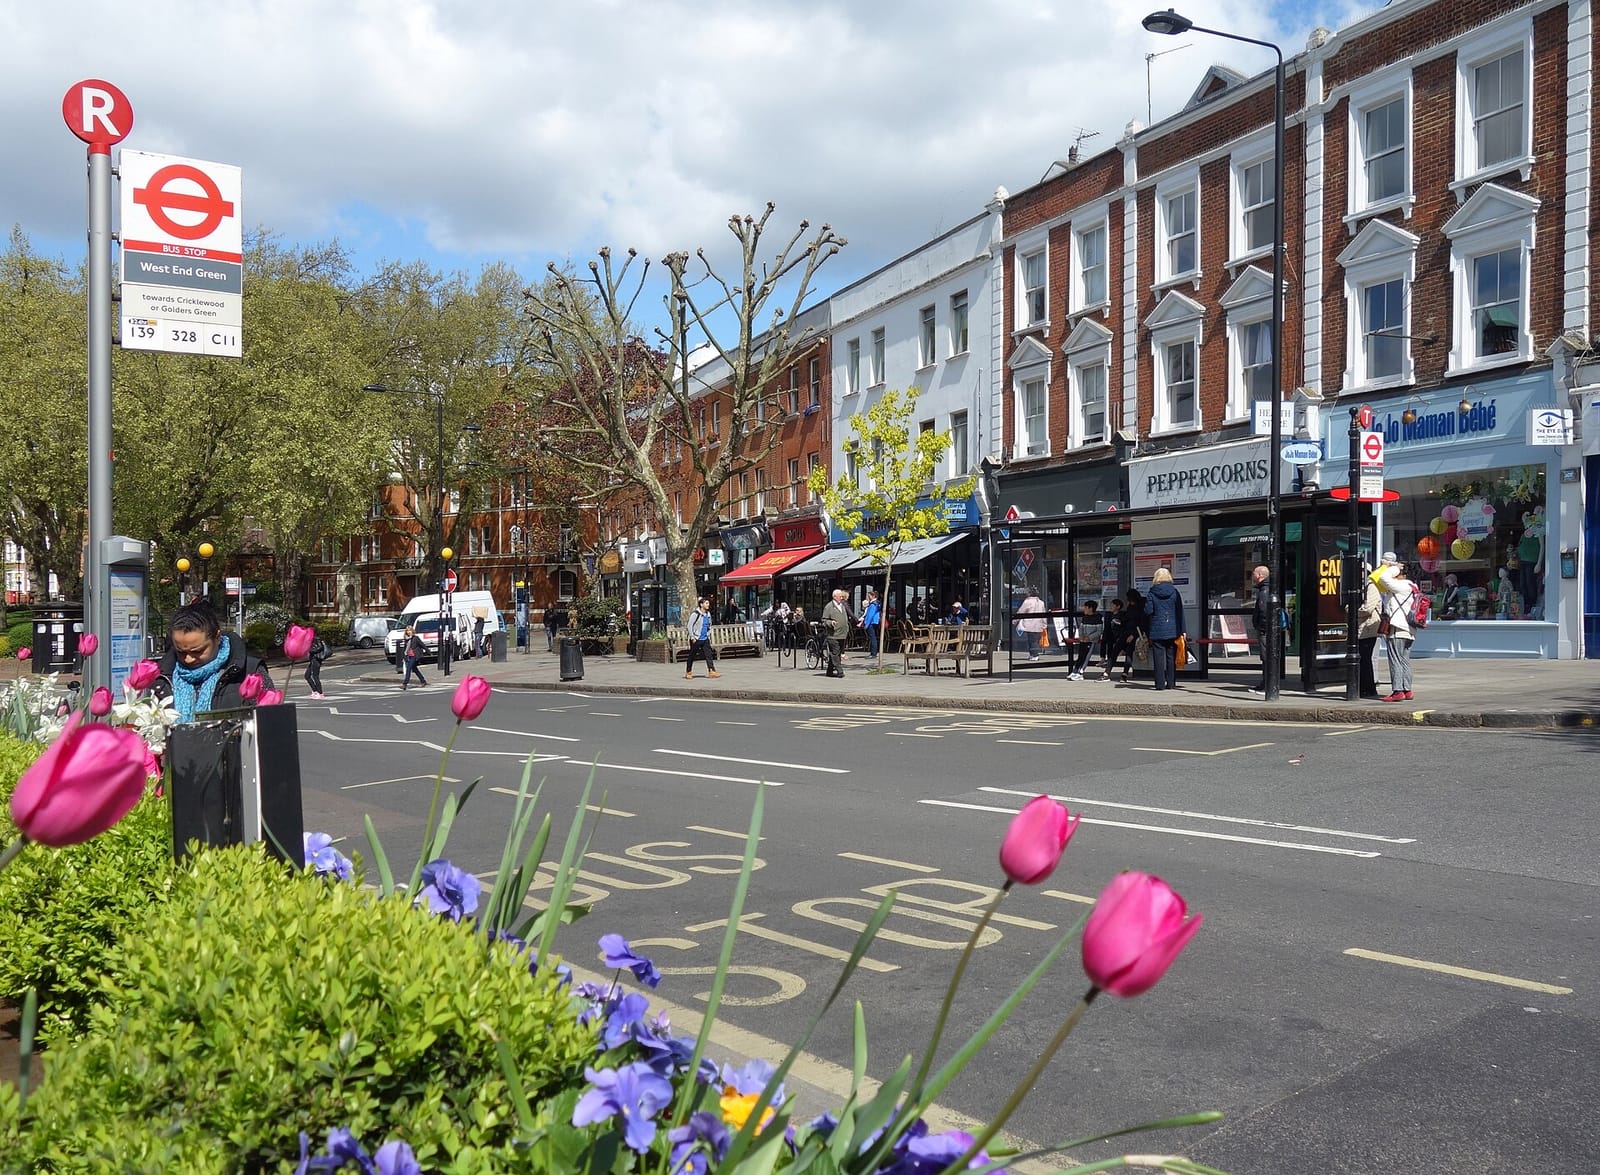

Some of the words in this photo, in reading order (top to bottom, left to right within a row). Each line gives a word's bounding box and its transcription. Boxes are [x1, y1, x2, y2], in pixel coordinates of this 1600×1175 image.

[82, 86, 121, 137] R
[162, 244, 180, 254] BUS
[184, 247, 207, 257] STOP
[140, 262, 170, 274] West
[172, 265, 193, 276] End
[195, 268, 227, 281] Green
[142, 294, 175, 303] towards
[176, 296, 225, 308] Cricklewood
[161, 305, 192, 314] Golders
[194, 308, 217, 317] Green
[131, 327, 155, 338] 139
[171, 330, 197, 342] 328
[211, 334, 235, 346] C11
[1259, 408, 1291, 418] HETH
[1363, 409, 1371, 425] T
[1262, 419, 1288, 428] STE
[1402, 408, 1455, 442] Maman
[1459, 399, 1496, 434] Bébé
[1148, 459, 1269, 494] PEPPERCORNS
[598, 878, 1059, 1006] STOP
